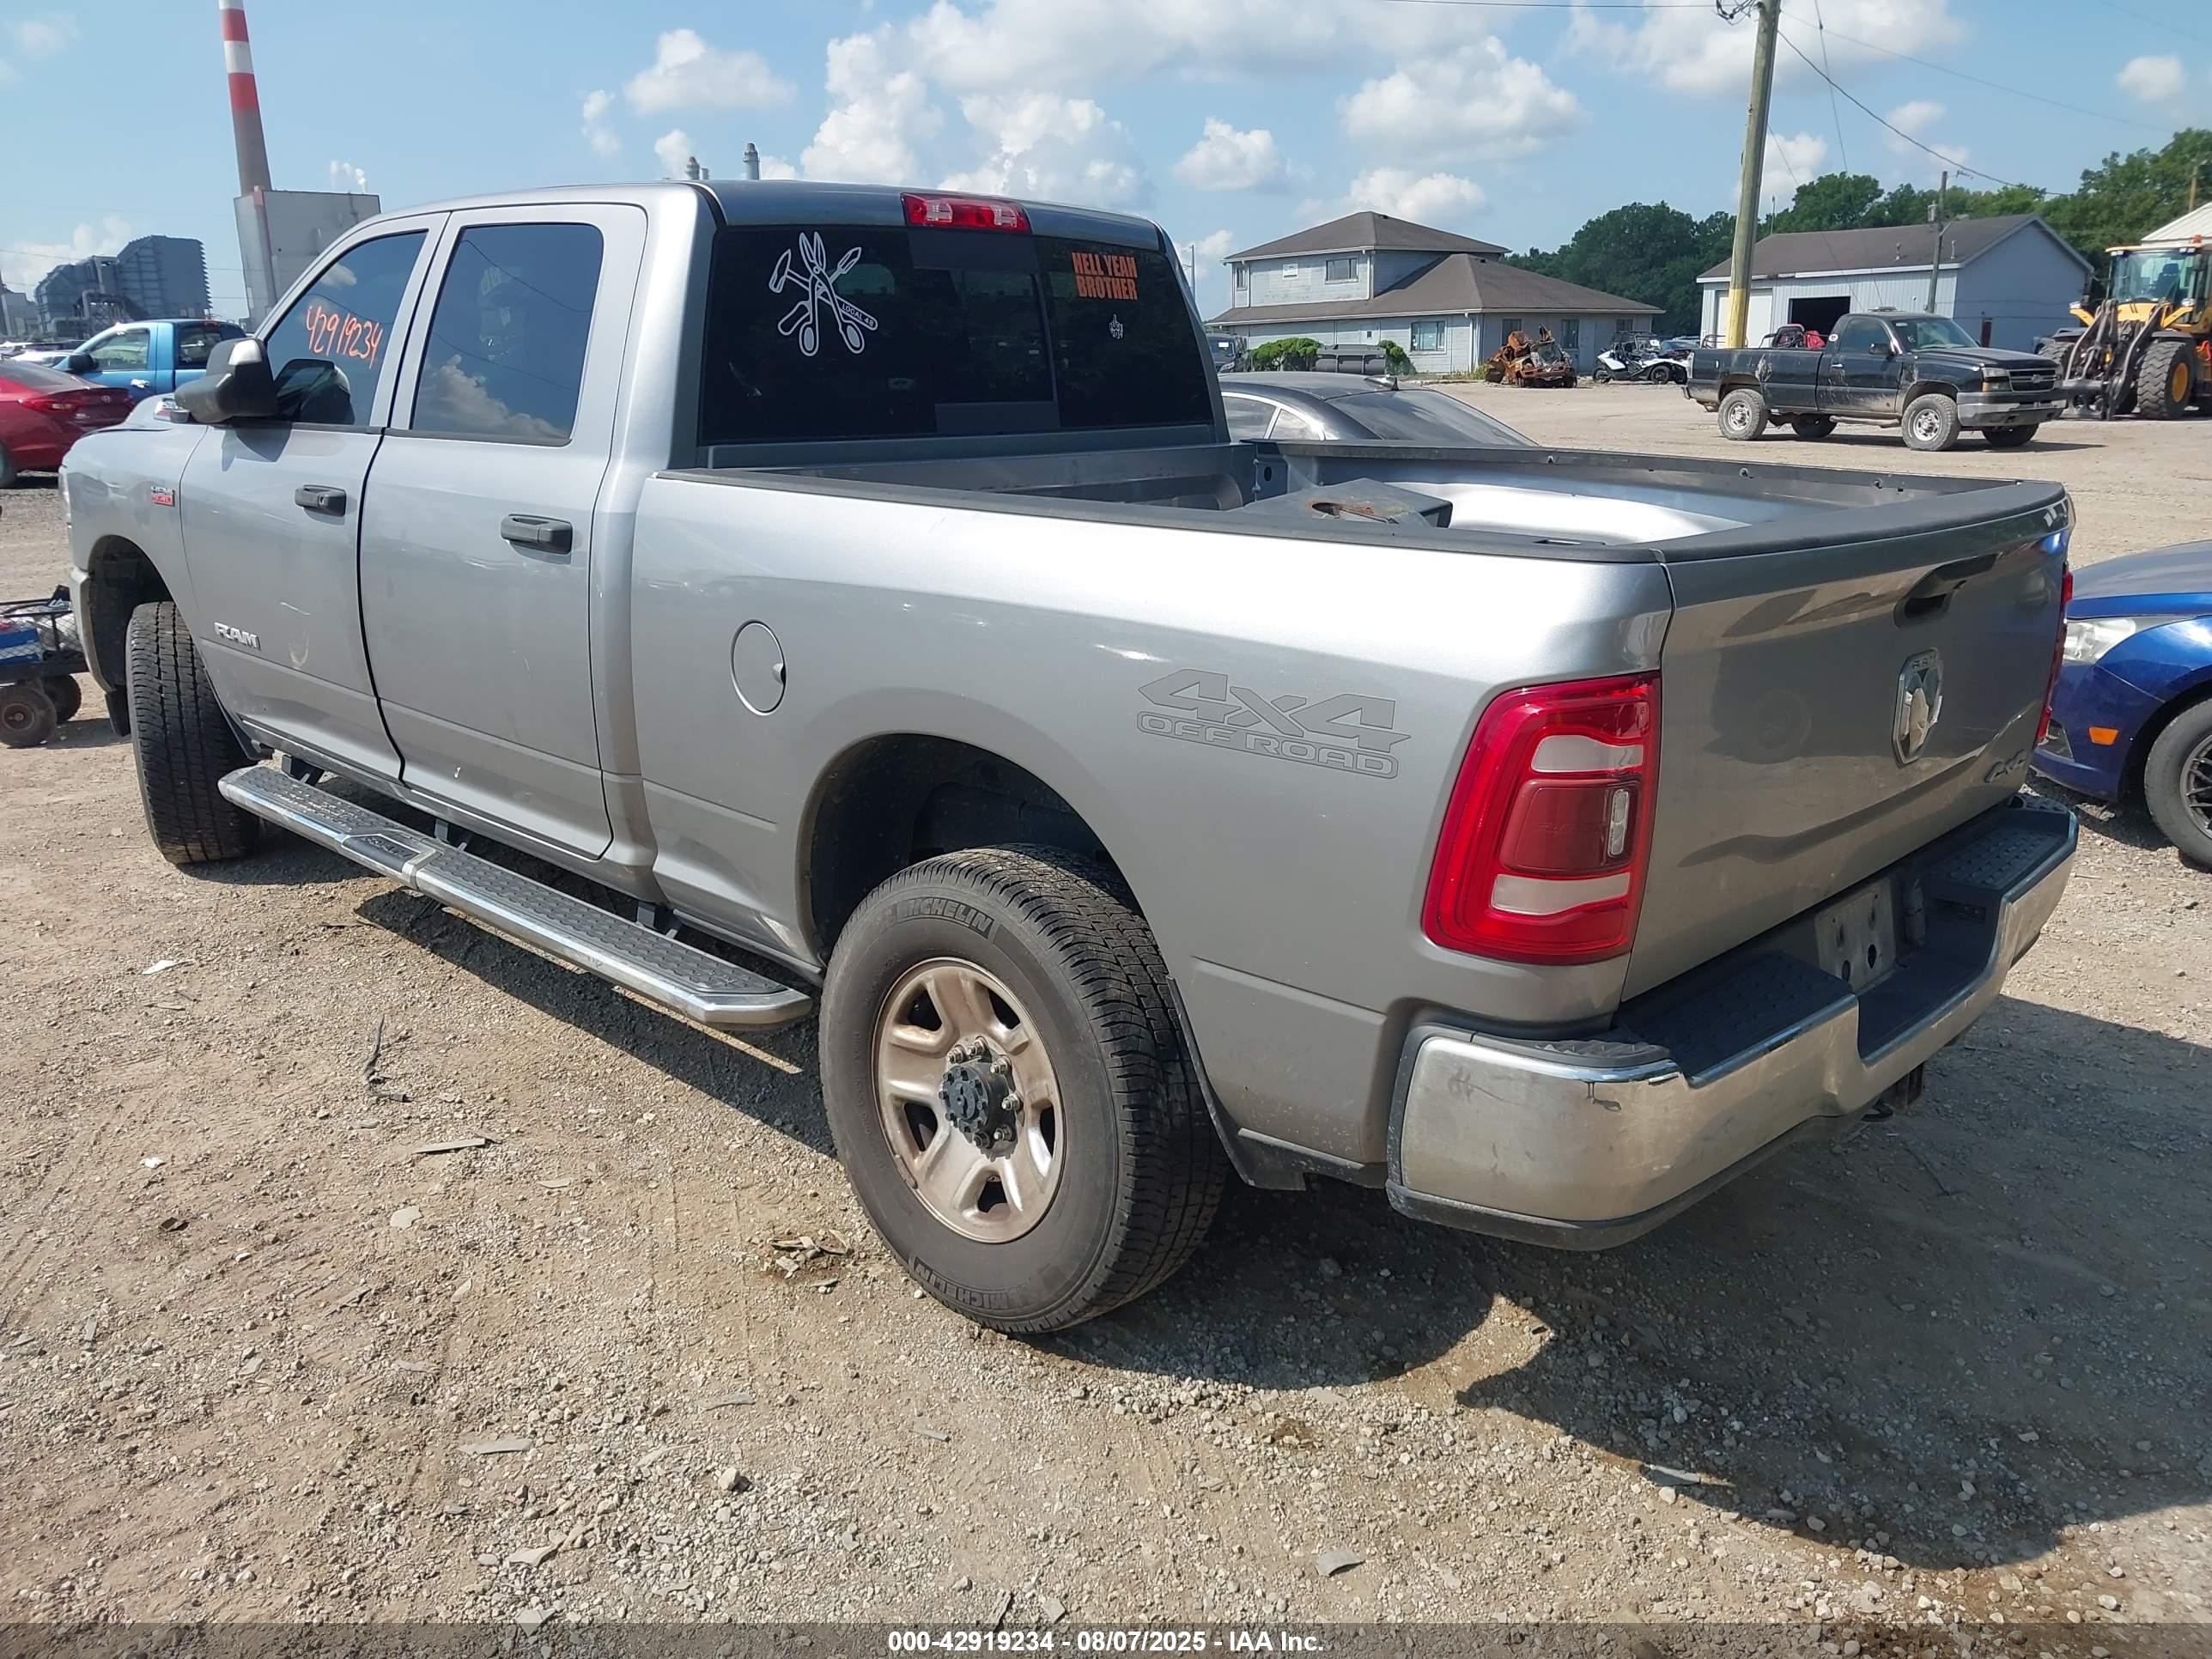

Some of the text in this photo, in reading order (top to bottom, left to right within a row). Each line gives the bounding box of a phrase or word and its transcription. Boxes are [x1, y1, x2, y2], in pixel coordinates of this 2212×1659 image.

[1072, 252, 1138, 277] HELL YEAH
[1076, 276, 1138, 301] BROTHER
[842, 303, 863, 321] LOCAL
[307, 306, 384, 369] 42919234
[214, 622, 258, 648] RAM
[1139, 714, 1395, 775] OFF ROAD
[896, 897, 994, 933] MICHELIN
